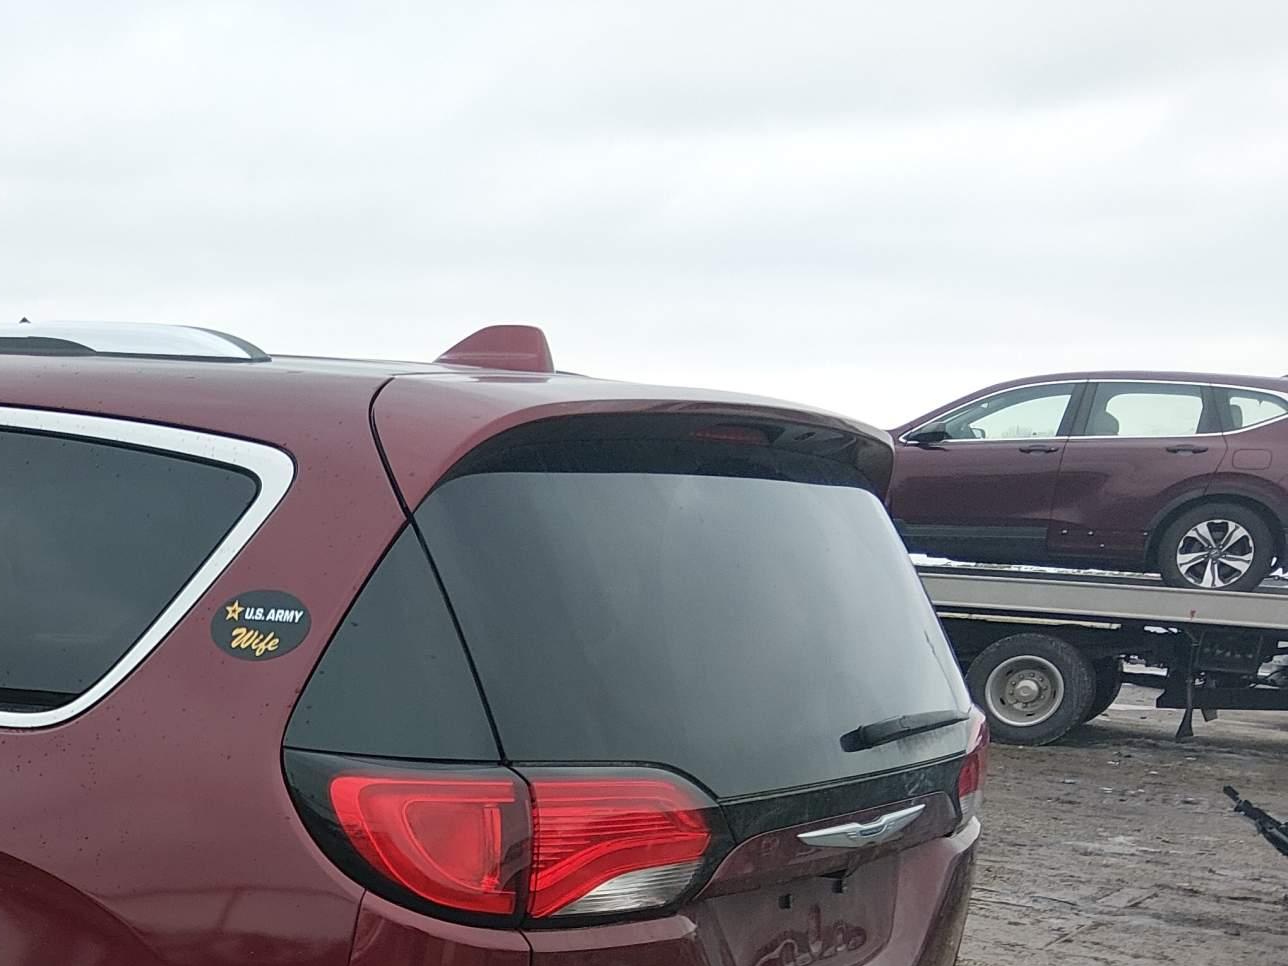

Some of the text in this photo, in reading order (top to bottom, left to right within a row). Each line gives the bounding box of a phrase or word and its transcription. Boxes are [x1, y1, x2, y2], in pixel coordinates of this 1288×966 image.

[244, 607, 303, 623] U.S. ARMY
[231, 627, 279, 656] Wife
